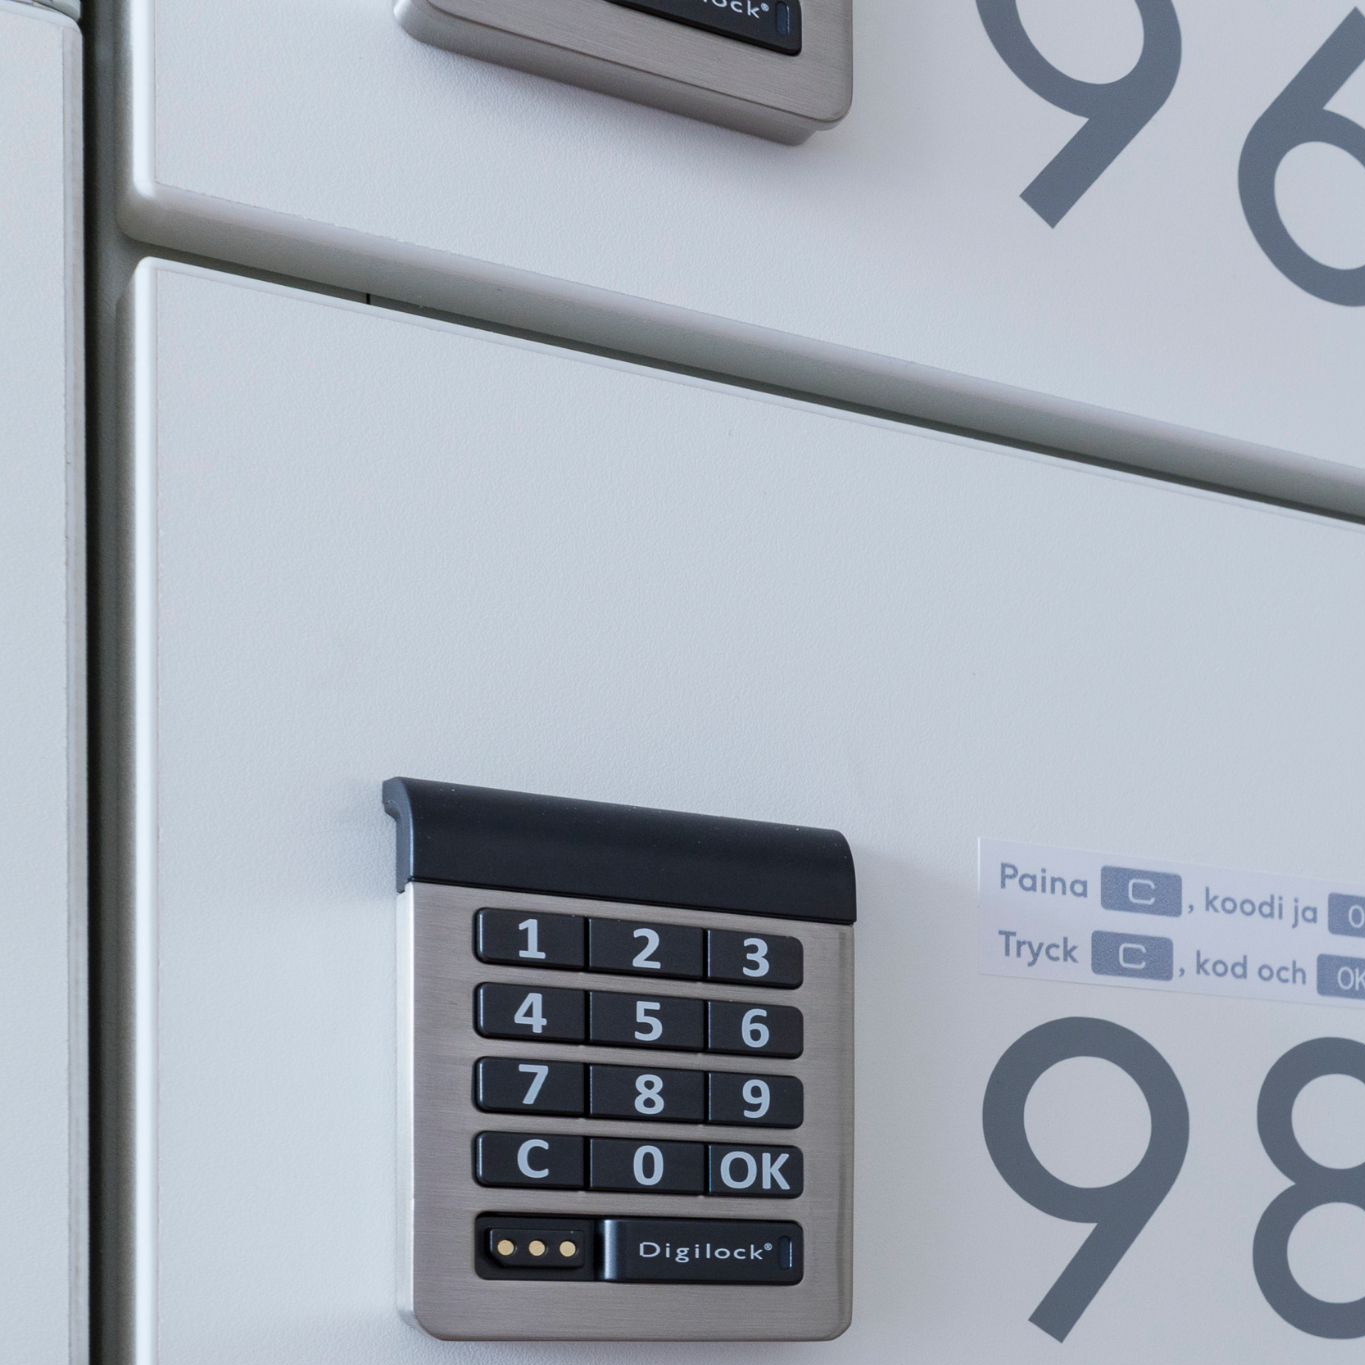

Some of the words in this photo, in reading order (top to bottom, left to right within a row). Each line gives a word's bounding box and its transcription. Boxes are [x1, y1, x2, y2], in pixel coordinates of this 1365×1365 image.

[1000, 862, 1088, 898] Paina
[1205, 886, 1283, 920] koodi
[1291, 895, 1318, 929] ja
[517, 919, 546, 959] 1
[631, 929, 661, 969] 2
[742, 938, 769, 977] 3
[999, 930, 1078, 966] Tryck
[1196, 950, 1247, 980] kod
[1258, 961, 1307, 985] och
[513, 993, 547, 1033] 4
[634, 1002, 663, 1041] 5
[741, 1009, 769, 1048] 6
[518, 1064, 548, 1104] 7
[634, 1074, 664, 1115] 8
[742, 1080, 770, 1118] 9
[517, 1139, 549, 1178] C
[633, 1146, 663, 1186] 0
[720, 1151, 789, 1190] OK
